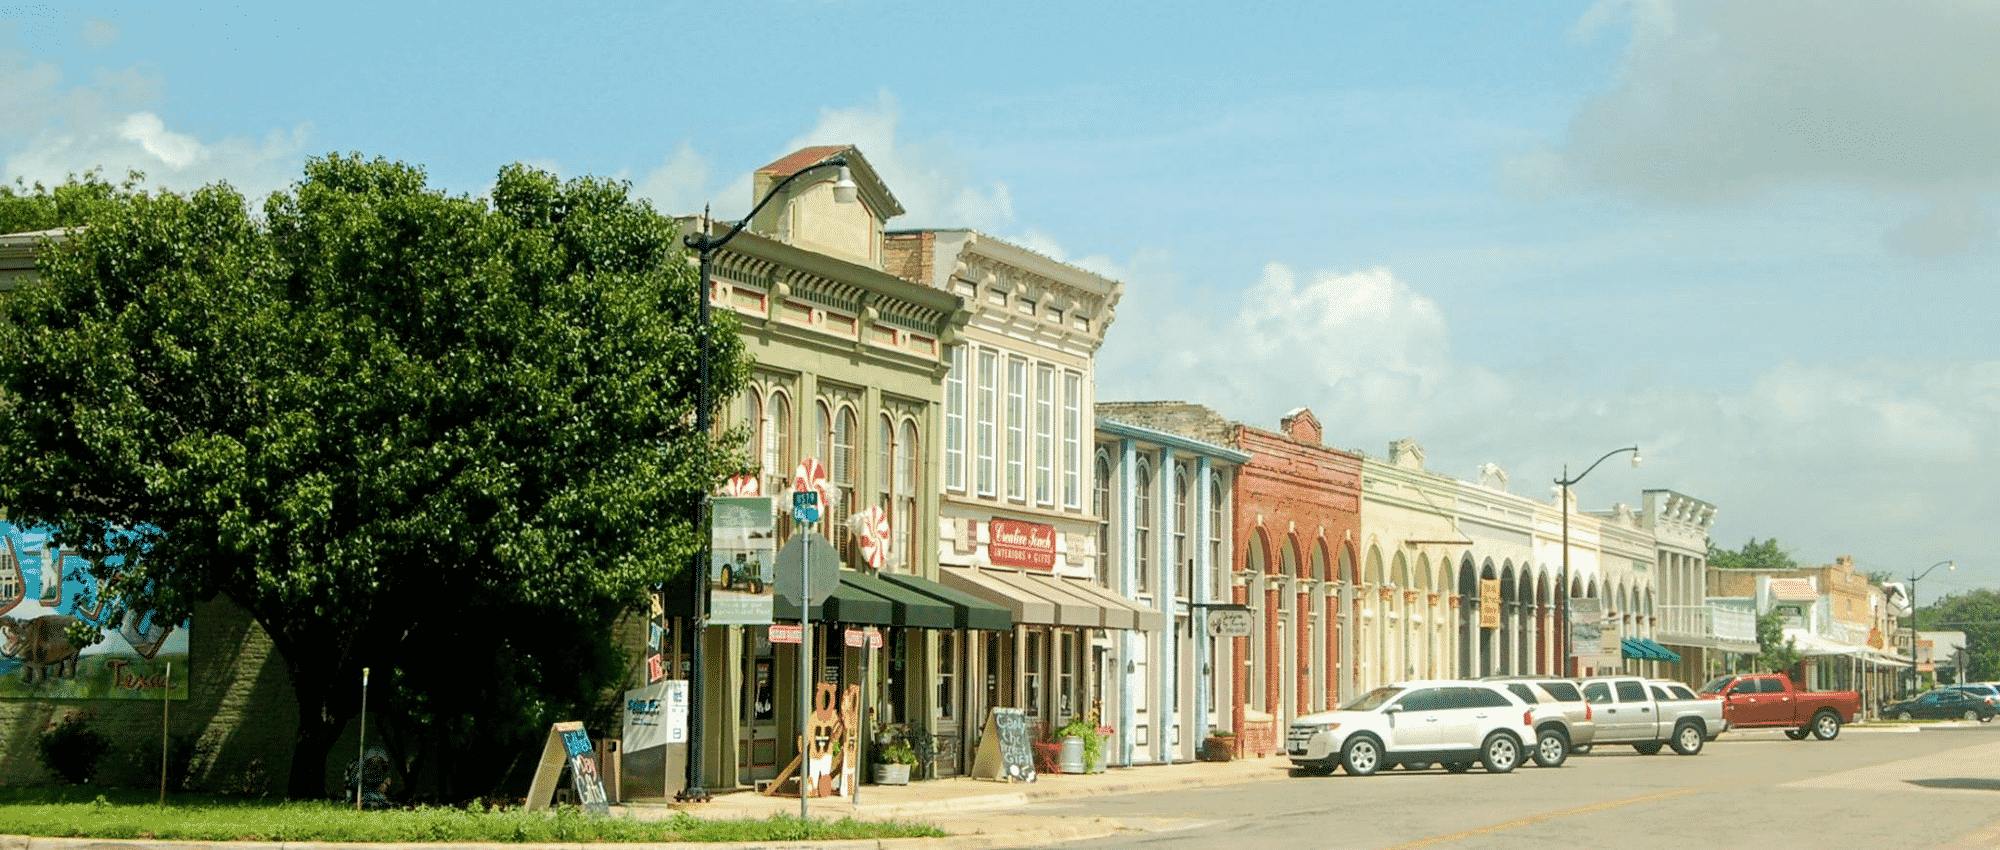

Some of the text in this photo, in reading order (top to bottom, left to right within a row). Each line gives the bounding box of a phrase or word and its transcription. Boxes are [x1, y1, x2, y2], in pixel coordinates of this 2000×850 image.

[994, 521, 1052, 549] Creative Touch
[993, 547, 1052, 564] INTERIORS GIFTS
